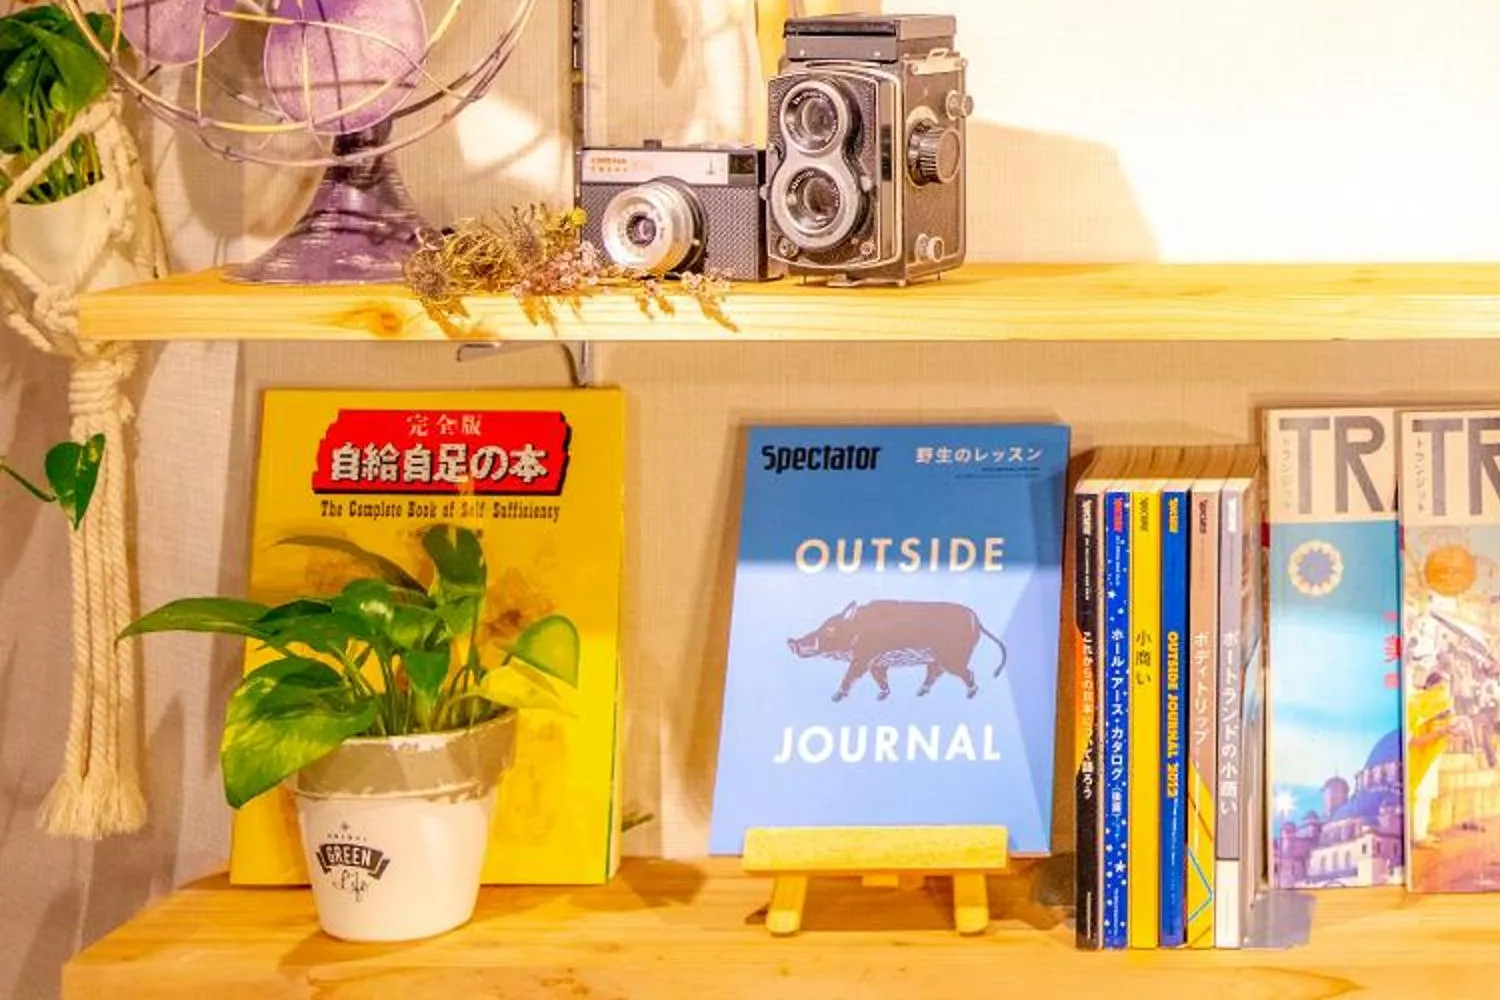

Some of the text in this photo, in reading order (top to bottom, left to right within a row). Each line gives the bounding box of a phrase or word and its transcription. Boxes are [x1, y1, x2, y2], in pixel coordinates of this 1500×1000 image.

[407, 414, 483, 437] 完全版
[331, 442, 548, 483] 自給自足の本
[762, 445, 881, 474] Spectator
[915, 446, 1043, 465] 野生のレッスン
[1279, 415, 1398, 515] TR
[321, 501, 343, 518] The
[349, 501, 402, 520] Complete
[408, 501, 437, 518] Book
[442, 501, 455, 518] of
[493, 501, 561, 523] Sufficiency
[795, 537, 1006, 574] OUTSIDE
[1136, 630, 1152, 686] 小商い
[773, 722, 1002, 764] JOURNAL
[325, 845, 372, 867] GREEN
